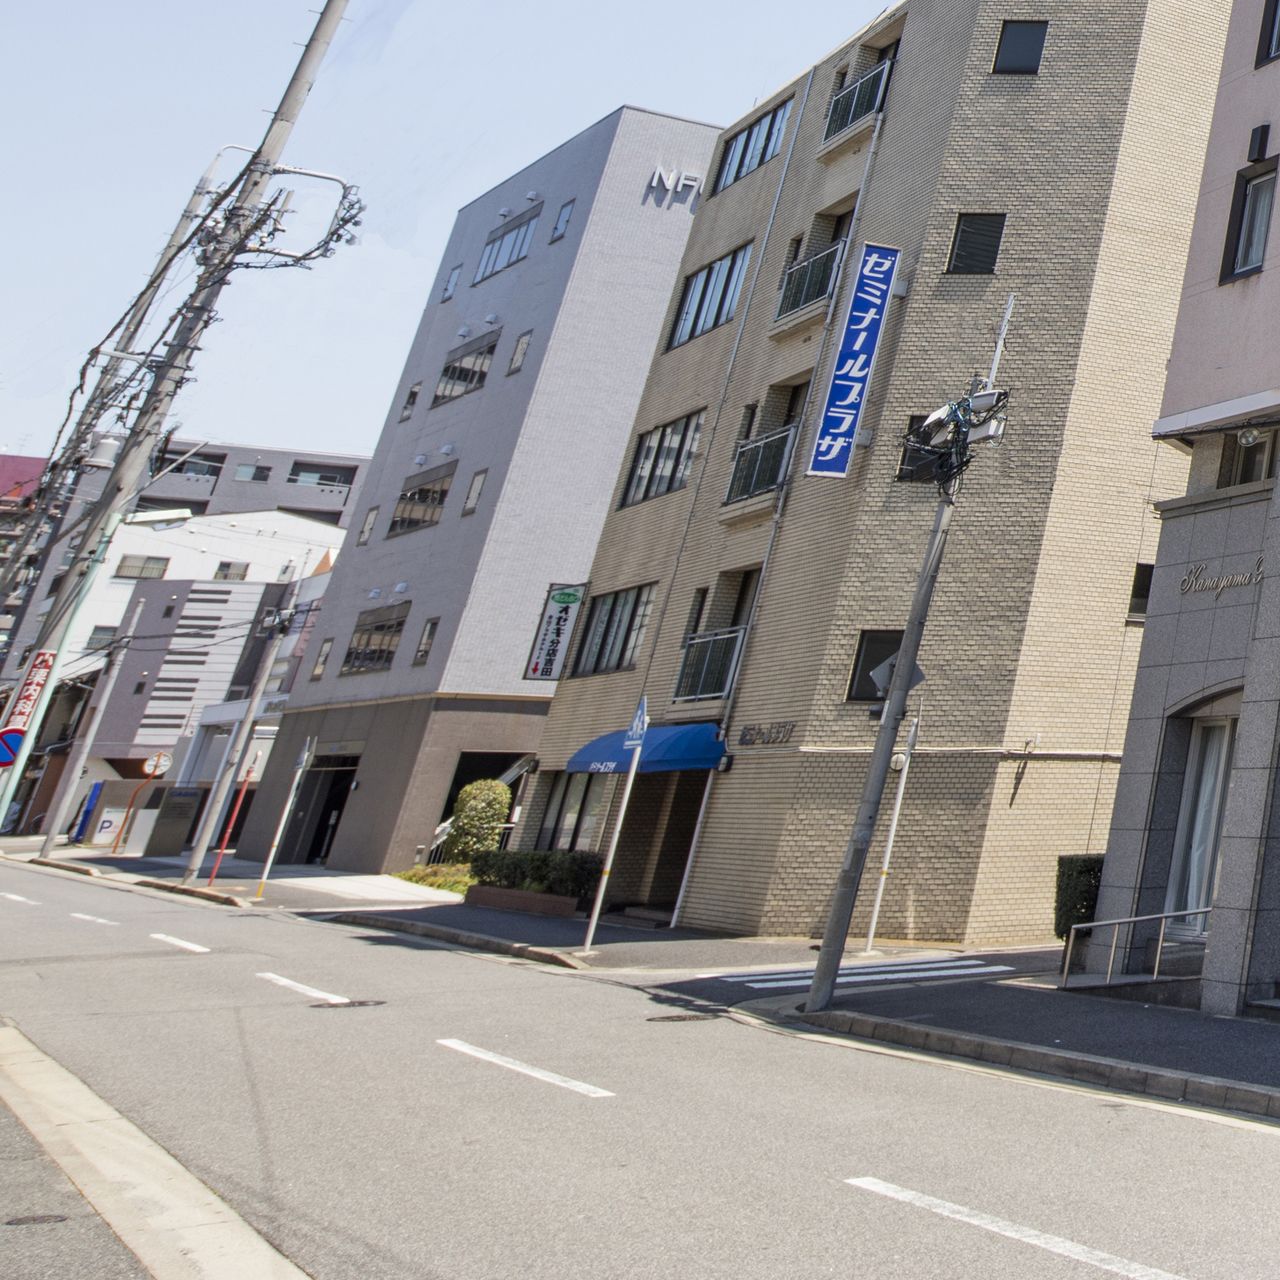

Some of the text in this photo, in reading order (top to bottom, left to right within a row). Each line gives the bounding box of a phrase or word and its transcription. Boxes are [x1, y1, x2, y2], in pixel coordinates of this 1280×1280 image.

[651, 166, 705, 195] NF
[817, 253, 895, 461] ゼミナールプラザ
[99, 820, 113, 834] P
